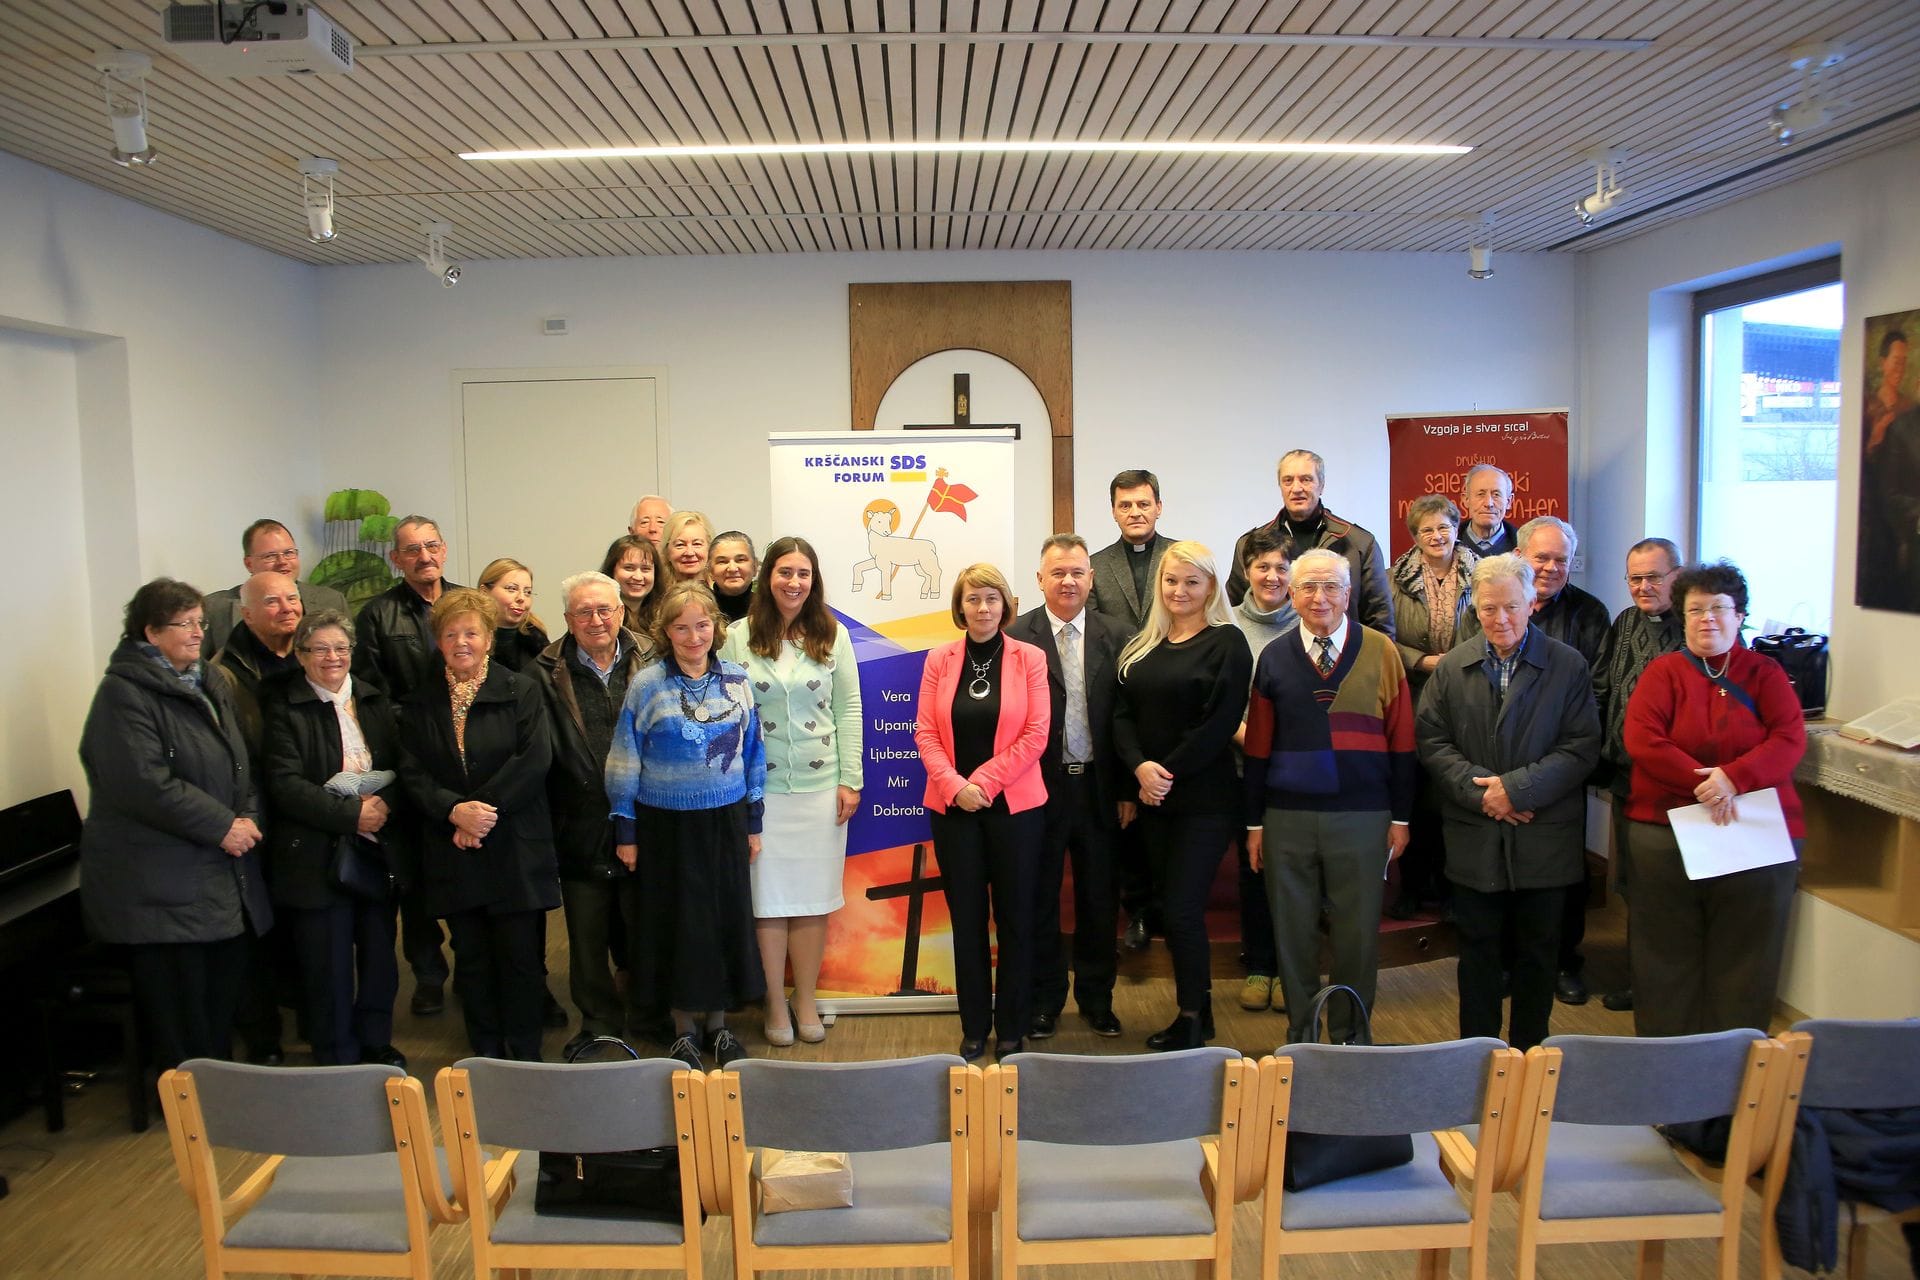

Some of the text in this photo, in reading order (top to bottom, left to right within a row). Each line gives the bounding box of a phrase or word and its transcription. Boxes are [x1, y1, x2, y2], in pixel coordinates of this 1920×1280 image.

[1423, 424, 1460, 436] Vzgoja
[1462, 423, 1473, 435] je
[1503, 421, 1529, 432] srca!
[805, 454, 927, 469] KRŠČANSKI SDS
[834, 472, 884, 483] FORUM
[882, 690, 911, 702] Vera
[887, 776, 910, 788] Mir
[873, 804, 924, 817] Dobrota
